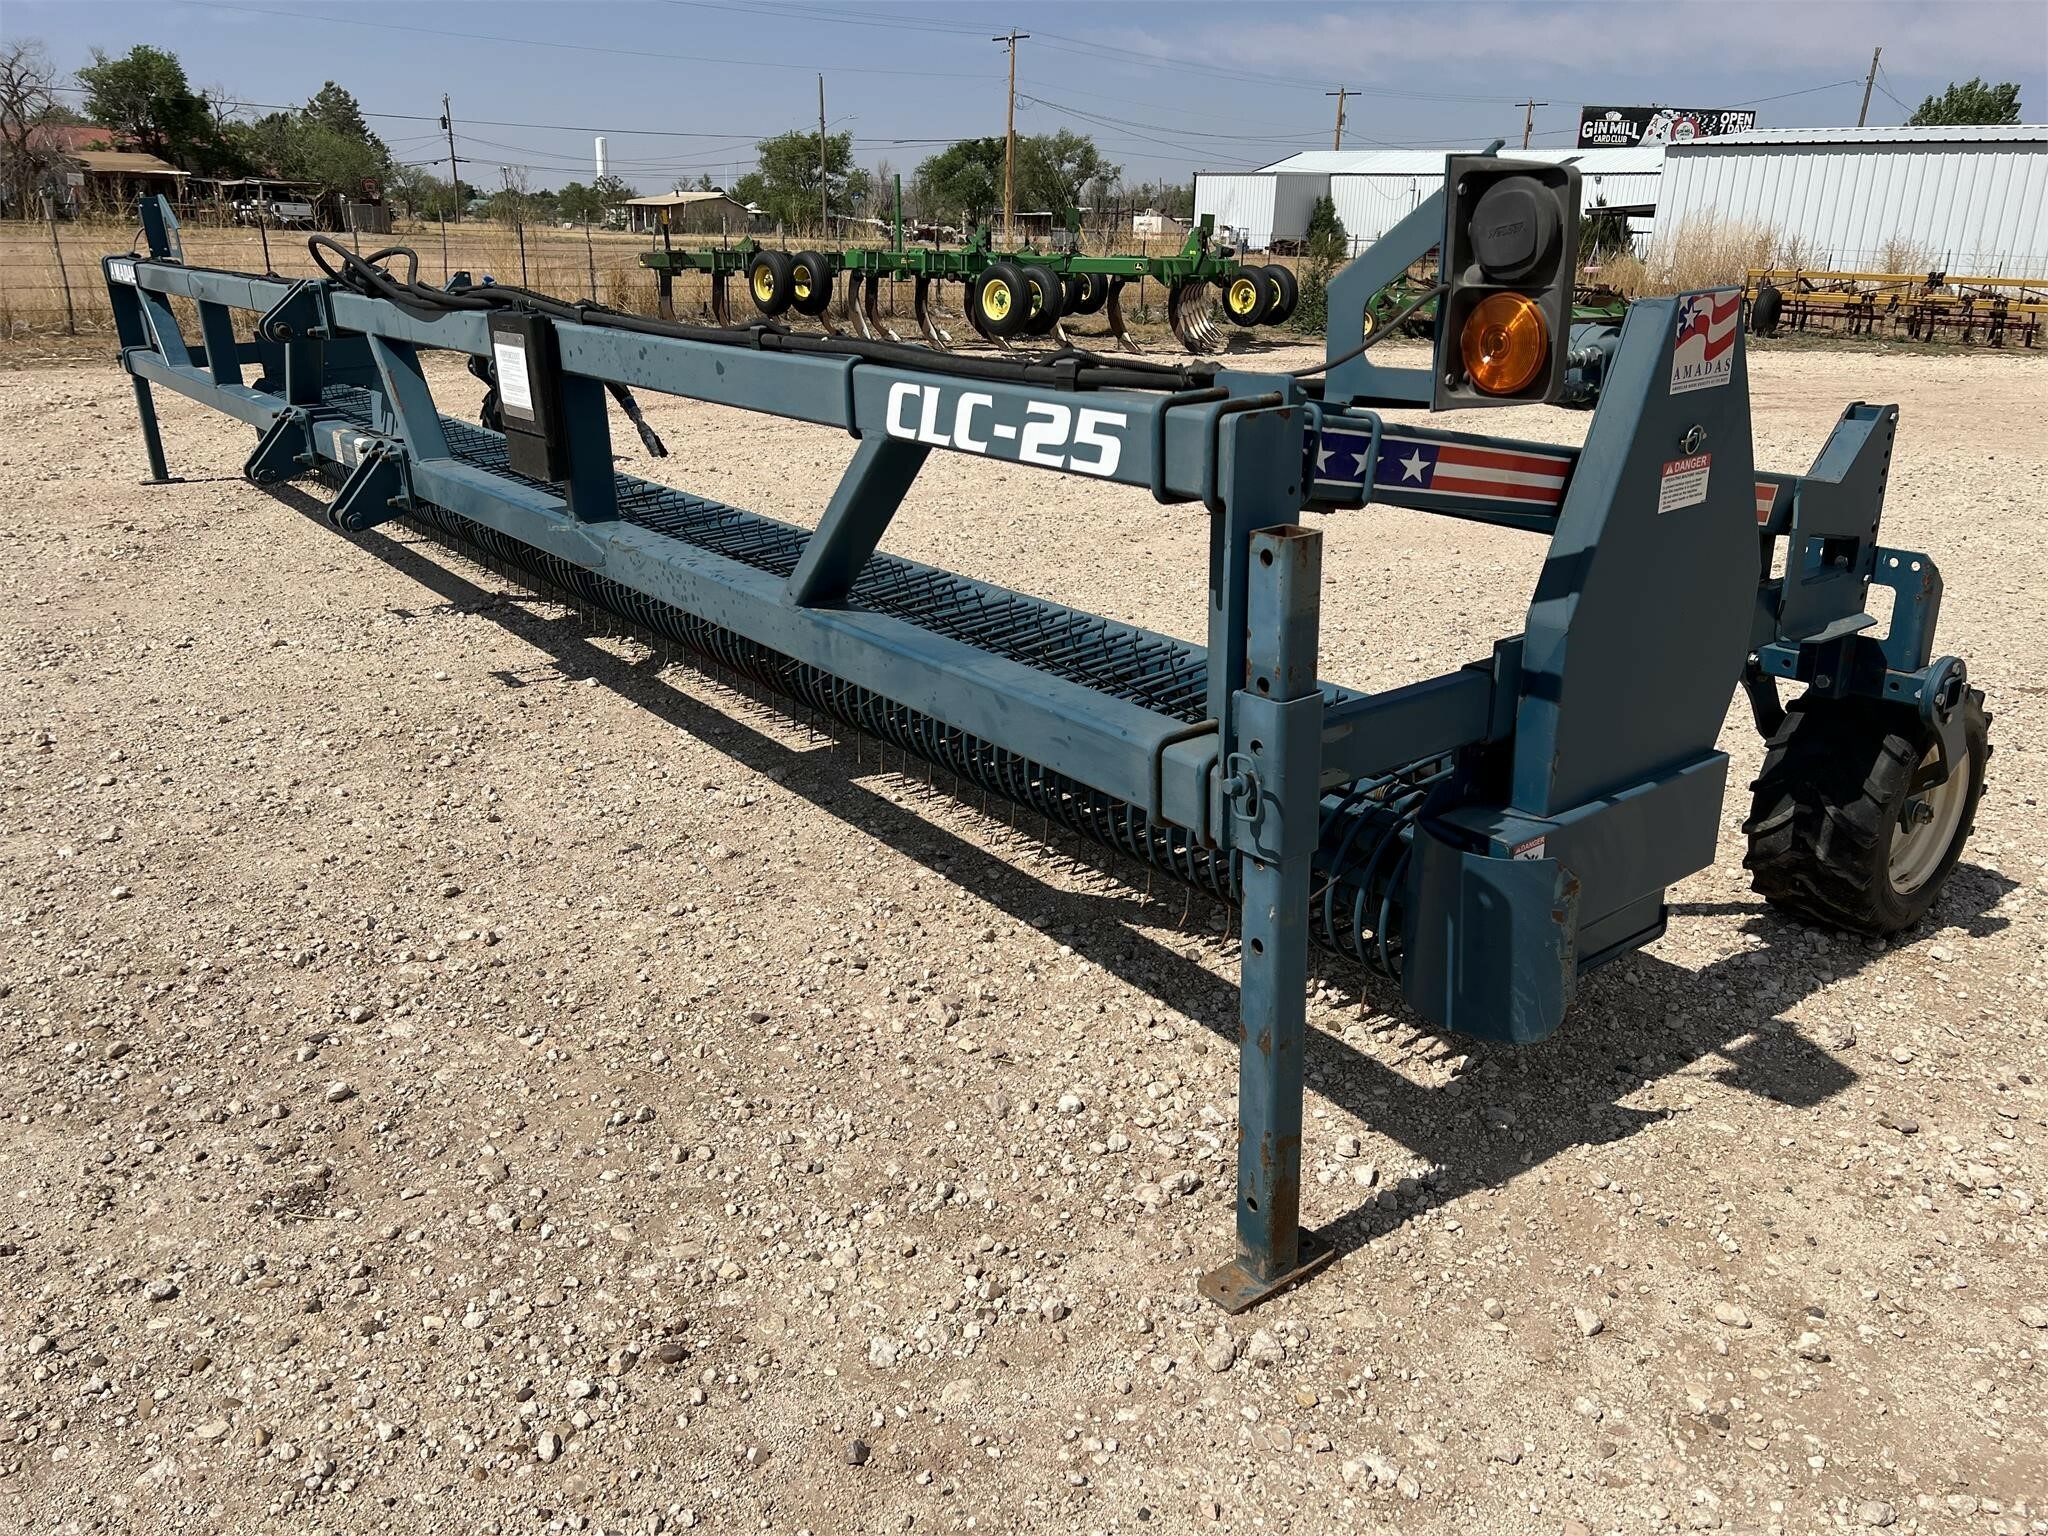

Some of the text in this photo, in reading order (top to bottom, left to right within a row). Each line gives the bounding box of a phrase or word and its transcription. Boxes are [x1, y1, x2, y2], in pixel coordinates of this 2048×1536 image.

[1720, 112, 1753, 125] OPEN
[1581, 121, 1640, 140] GIN MILL
[1720, 124, 1727, 133] 7
[1593, 134, 1628, 143] CARD CLUB
[1673, 358, 1731, 380] AMADAS
[886, 381, 1128, 477] CLC-25
[1674, 456, 1707, 473] DANGER
[1520, 836, 1545, 852] DANGER
